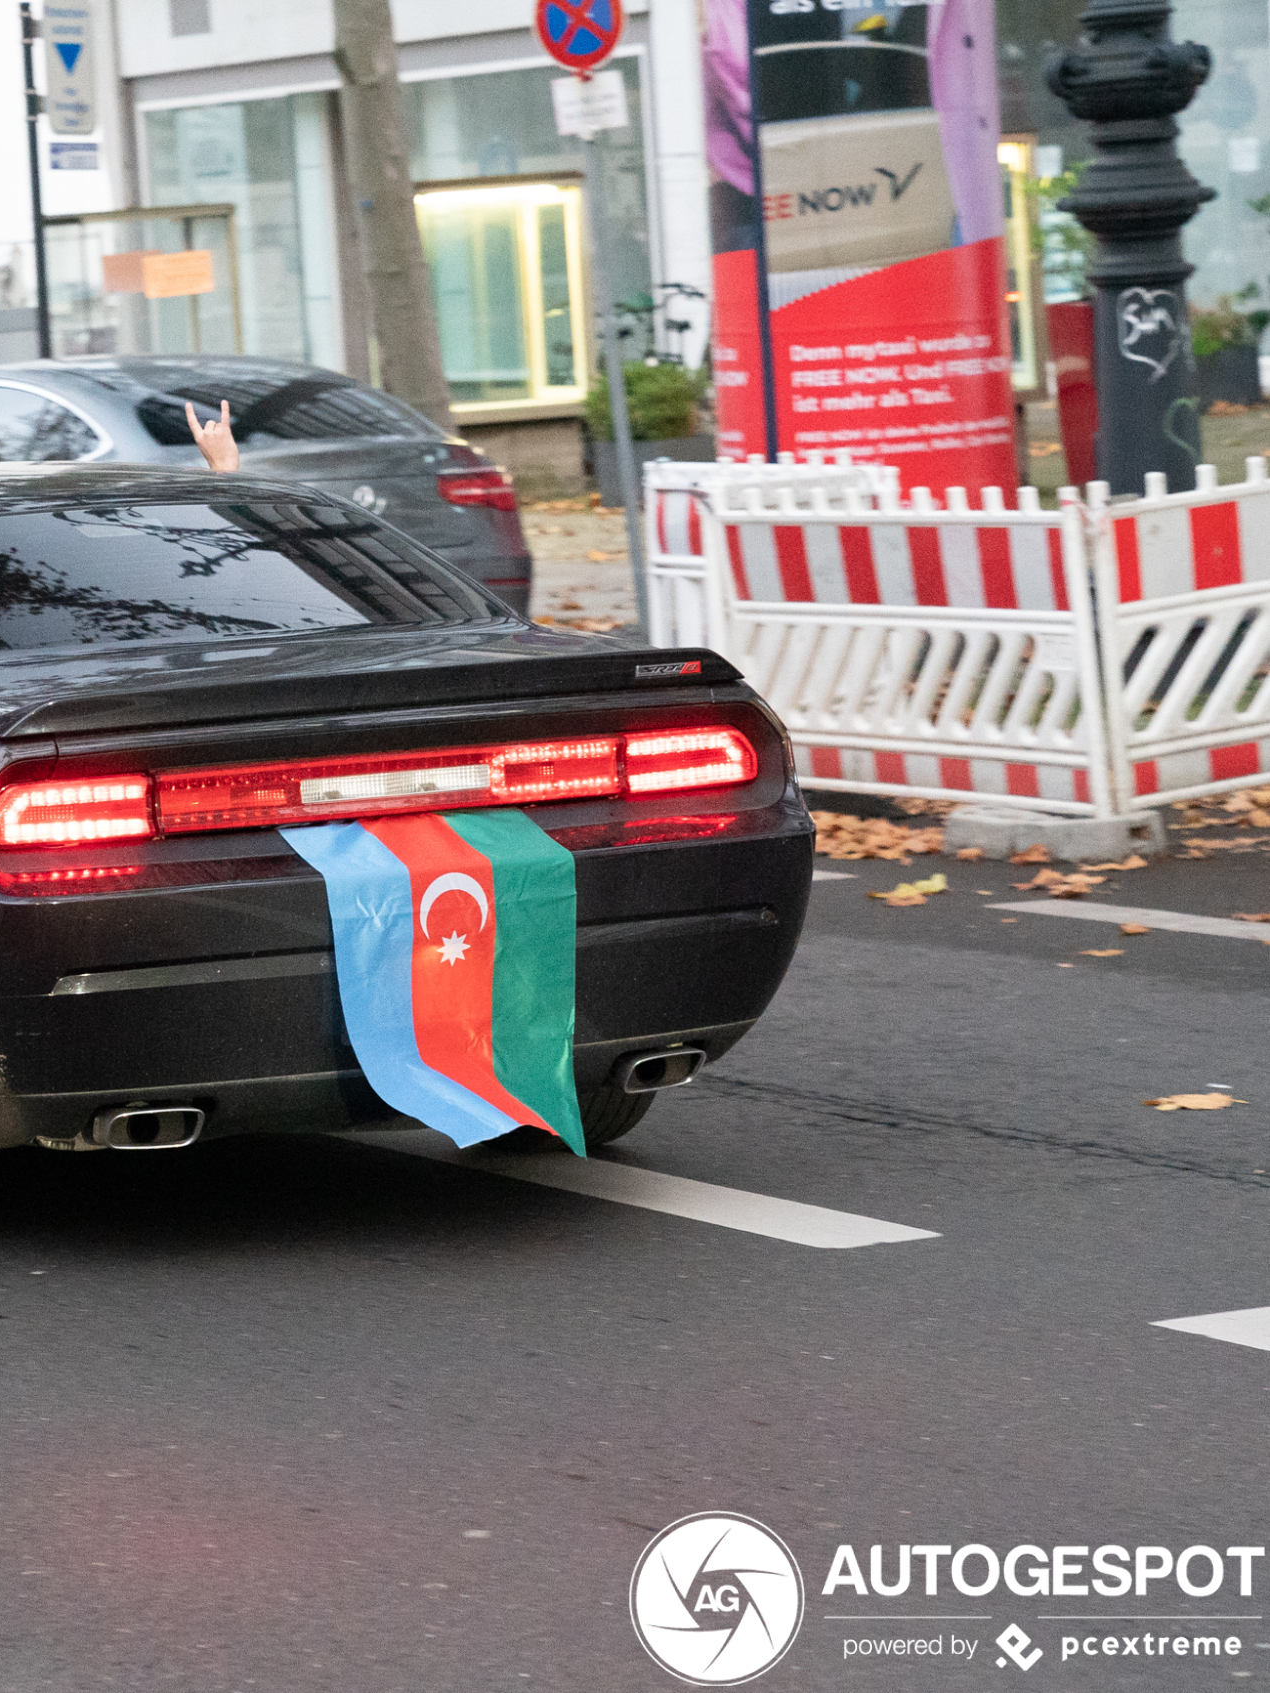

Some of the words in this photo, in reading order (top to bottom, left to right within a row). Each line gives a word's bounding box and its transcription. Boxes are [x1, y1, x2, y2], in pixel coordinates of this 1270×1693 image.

[797, 183, 878, 216] NOW
[790, 345, 842, 362] Denn
[845, 336, 916, 361] mytaxi
[791, 369, 842, 387] FREE
[792, 395, 820, 412] ist
[821, 392, 876, 411] mehr
[878, 389, 909, 407] als
